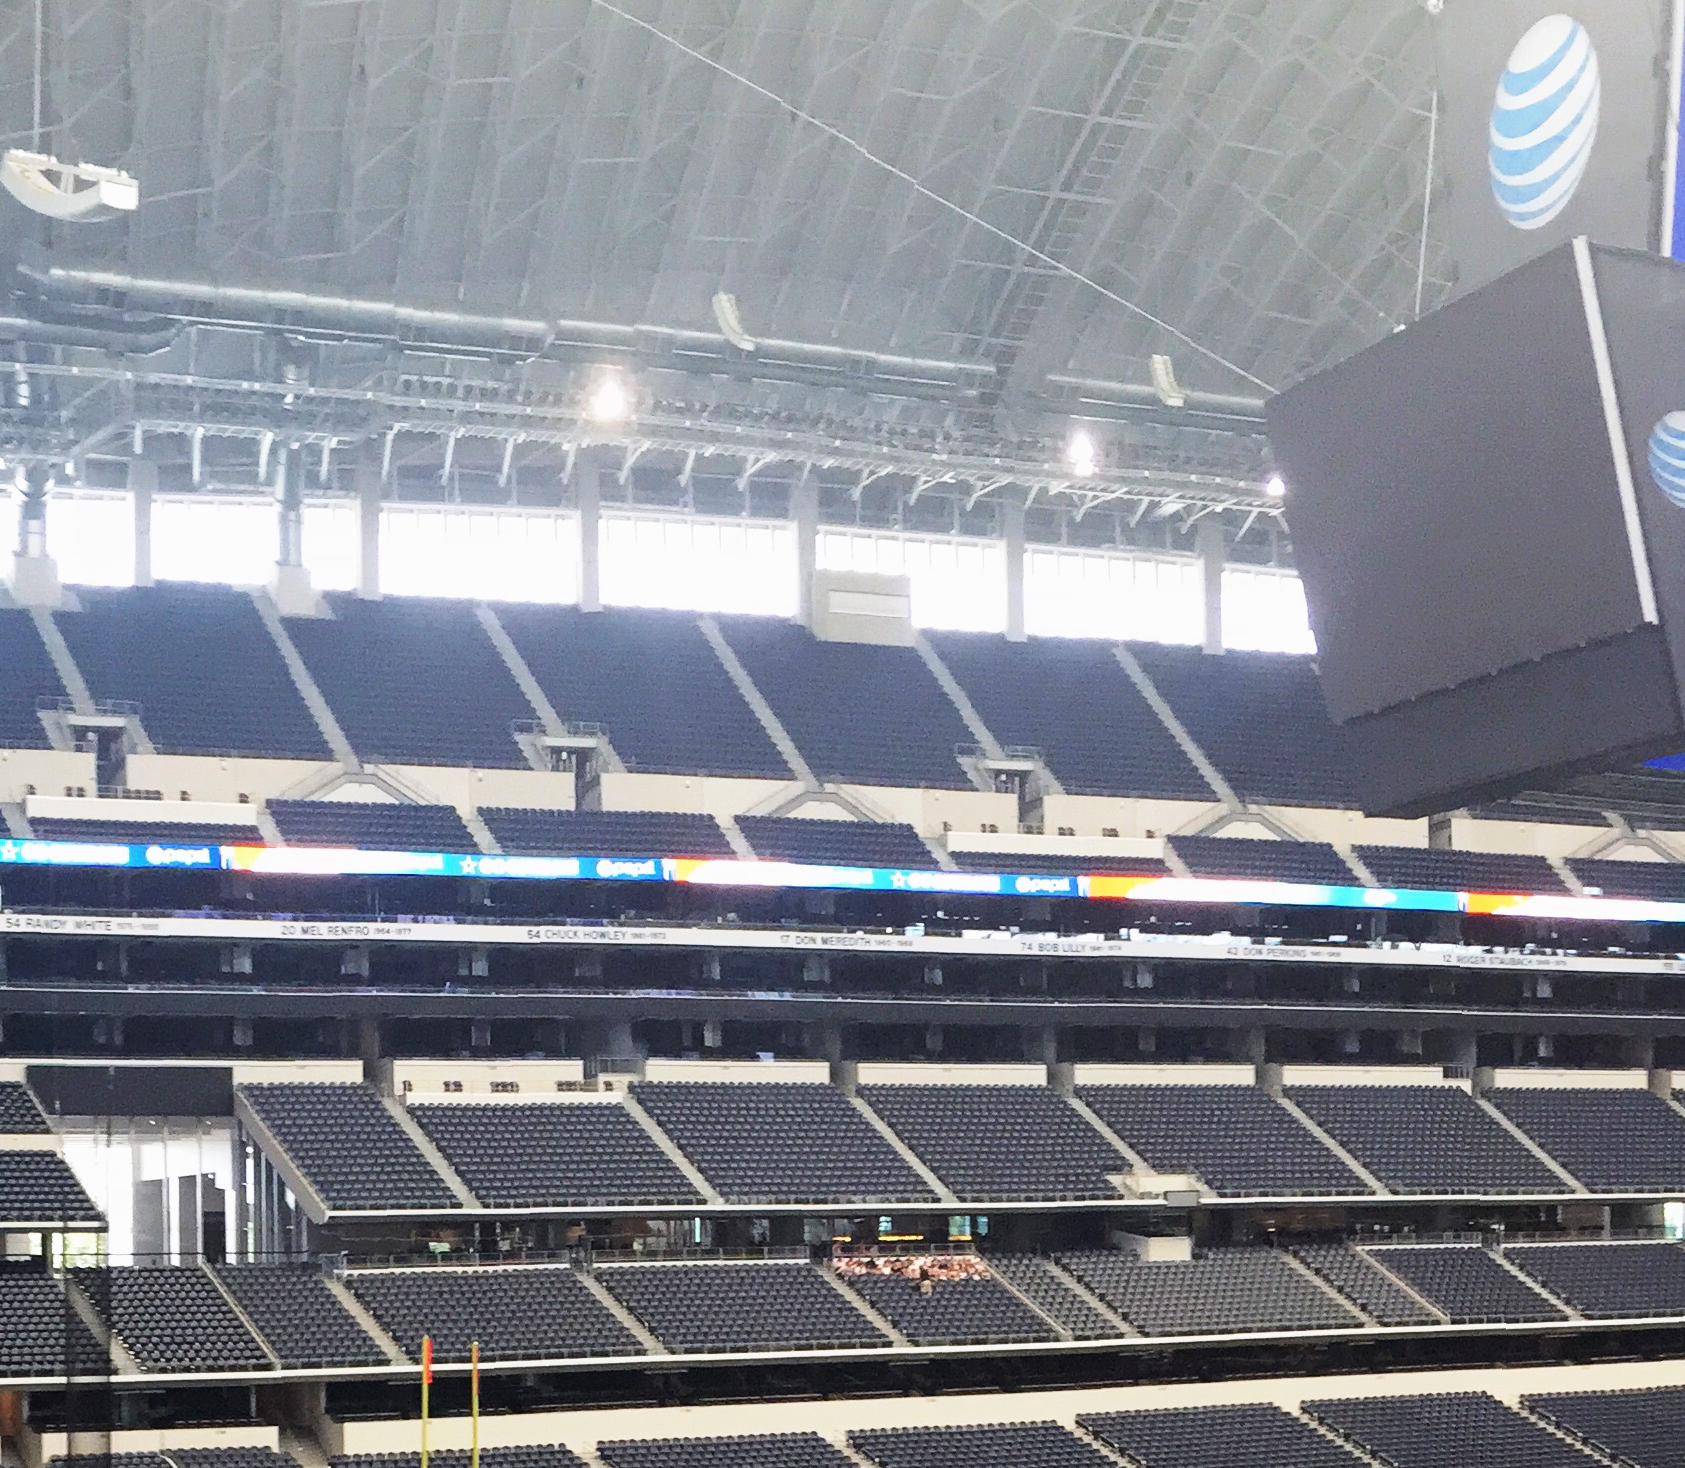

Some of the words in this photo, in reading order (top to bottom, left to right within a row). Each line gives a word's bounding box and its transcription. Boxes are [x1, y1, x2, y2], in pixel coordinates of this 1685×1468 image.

[6, 918, 20, 928] 54
[25, 918, 67, 929] RANDY
[73, 920, 113, 931] WHITE
[281, 925, 296, 936] 20
[301, 926, 323, 936] MEL
[327, 926, 370, 936] RENFRO
[527, 929, 541, 939] 54
[544, 929, 580, 940] CHUCK
[583, 930, 628, 941] HOWLEY
[795, 935, 817, 945] DON
[820, 936, 871, 947] MEREDITH
[1021, 942, 1033, 951] 74
[1038, 942, 1059, 952] BOB
[1062, 943, 1086, 953] LILLY
[1443, 954, 1452, 963] 12
